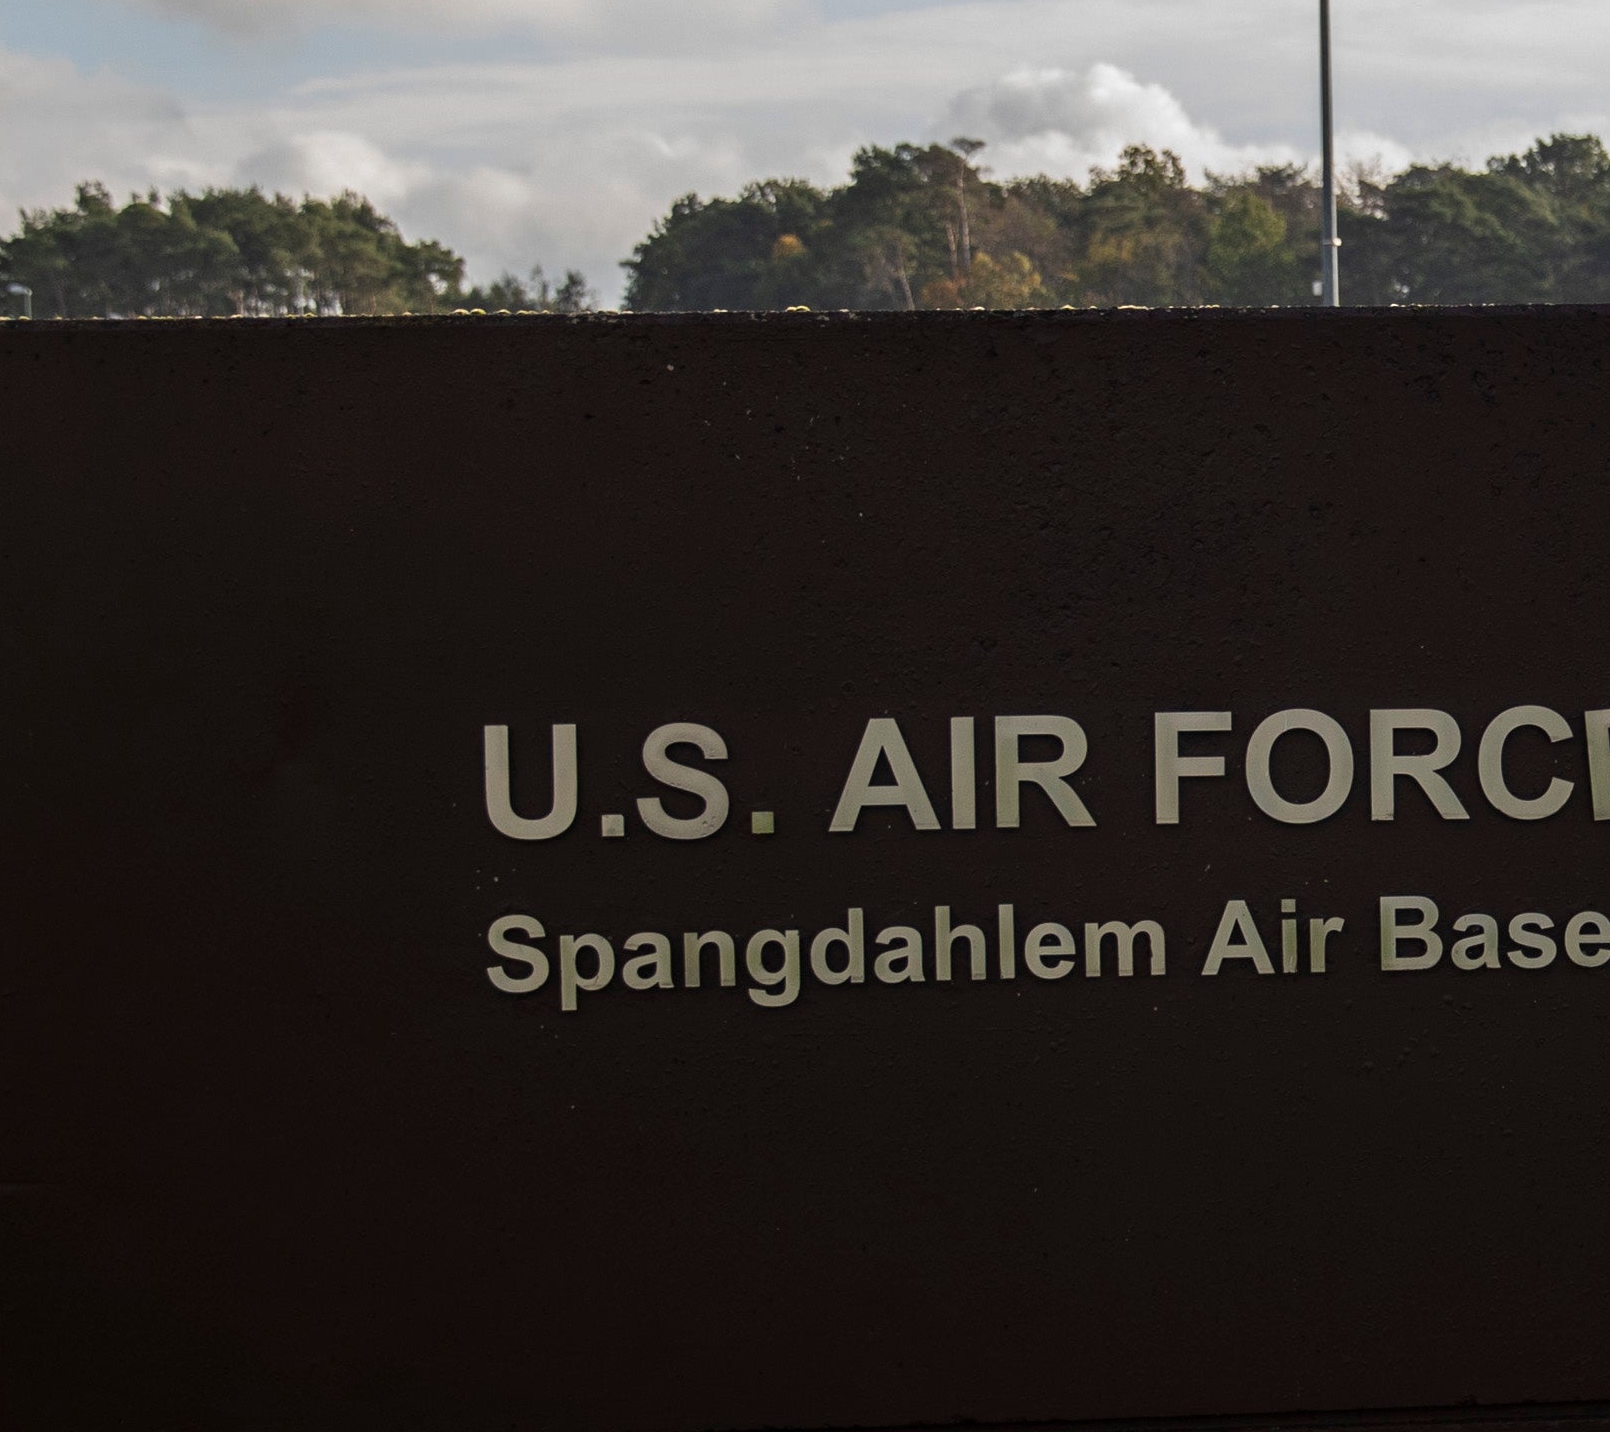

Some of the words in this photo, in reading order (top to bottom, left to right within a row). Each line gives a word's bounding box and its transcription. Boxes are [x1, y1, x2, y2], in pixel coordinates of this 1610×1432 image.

[484, 722, 774, 840] U.S.
[828, 715, 1097, 831] AIR
[487, 904, 1165, 1011] Spangdahlem
[1202, 899, 1345, 976] Air
